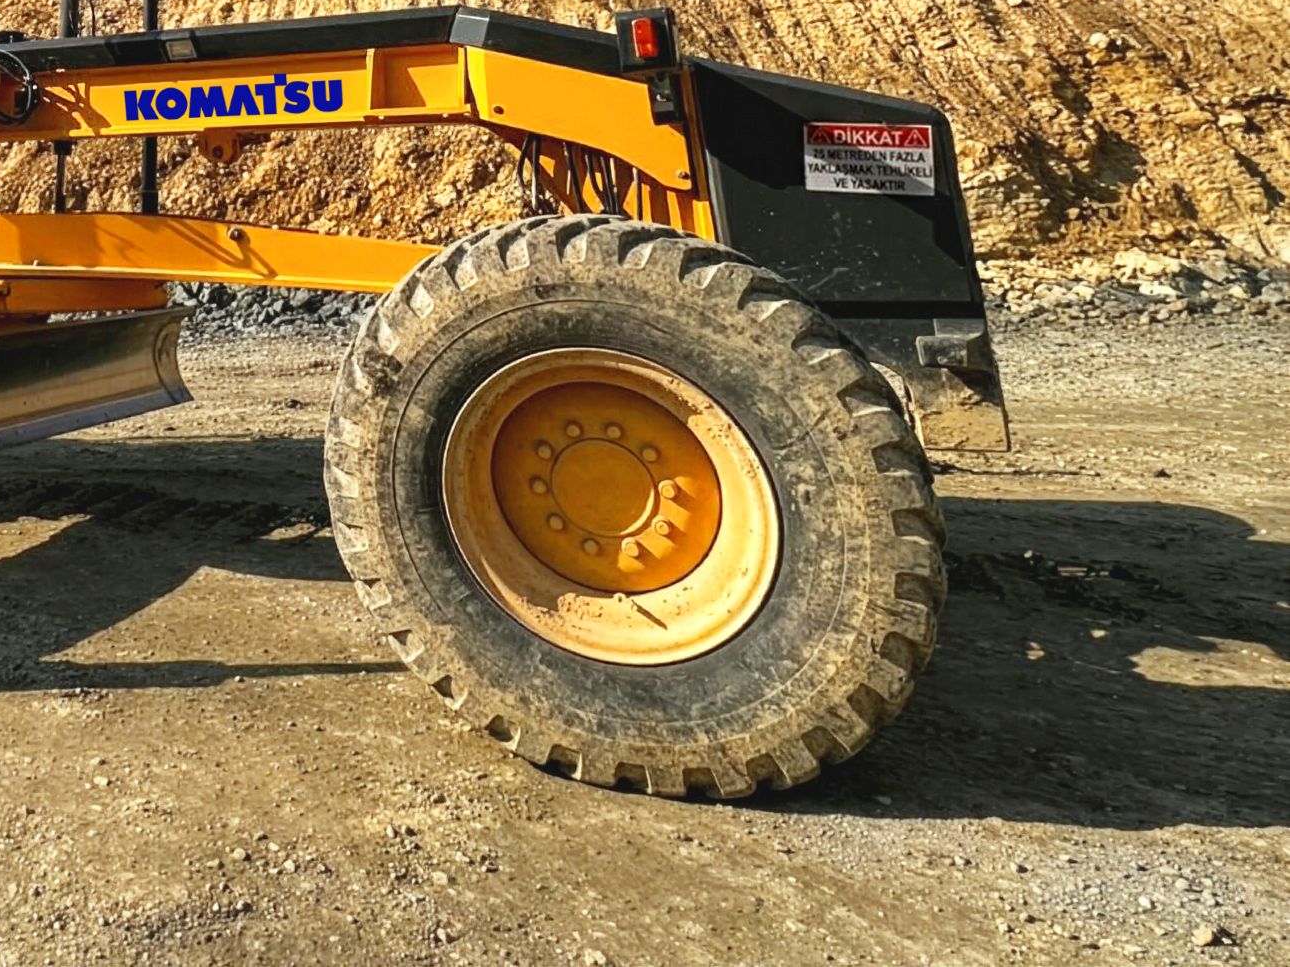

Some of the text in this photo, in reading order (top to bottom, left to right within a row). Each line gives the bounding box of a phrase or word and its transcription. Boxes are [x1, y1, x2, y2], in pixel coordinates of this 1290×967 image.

[124, 73, 343, 121] KOMATSU
[833, 127, 903, 146] DİKKAT
[827, 149, 886, 162] METREDEN
[890, 152, 926, 163] FAZLA
[808, 162, 932, 178] YAKLAŞMAK TEHLİKELİ
[834, 178, 906, 191] VE YASAKTIR
